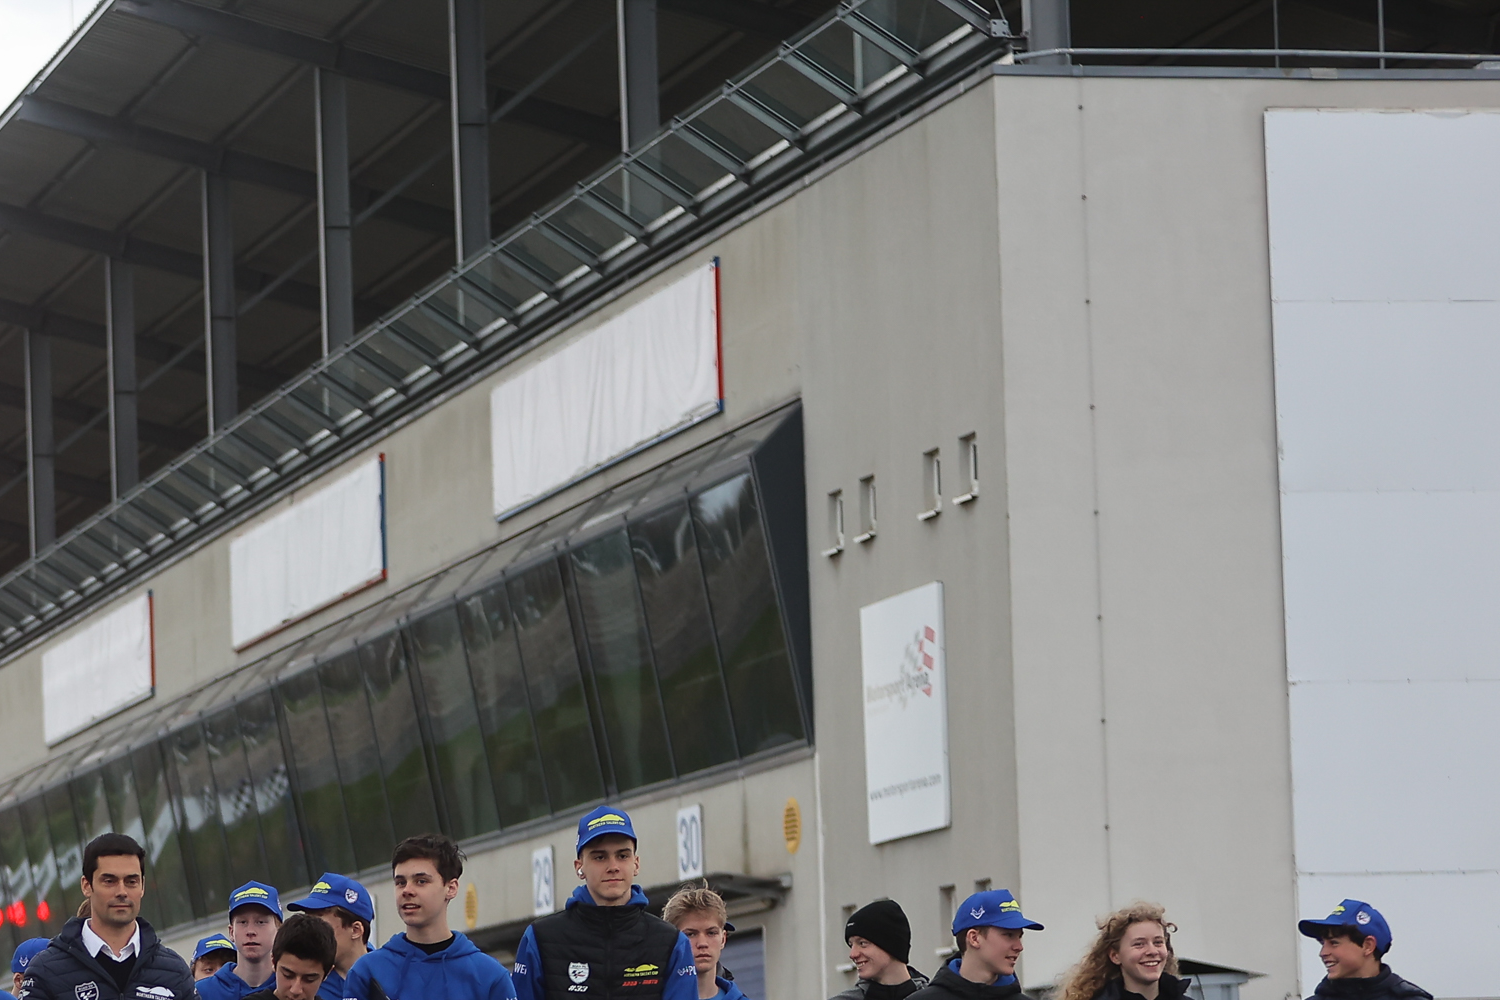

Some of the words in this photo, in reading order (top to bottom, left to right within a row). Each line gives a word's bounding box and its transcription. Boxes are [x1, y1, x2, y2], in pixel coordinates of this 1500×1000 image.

[679, 814, 698, 872] 30
[535, 856, 551, 908] 29
[136, 991, 154, 1000] NORTHERN
